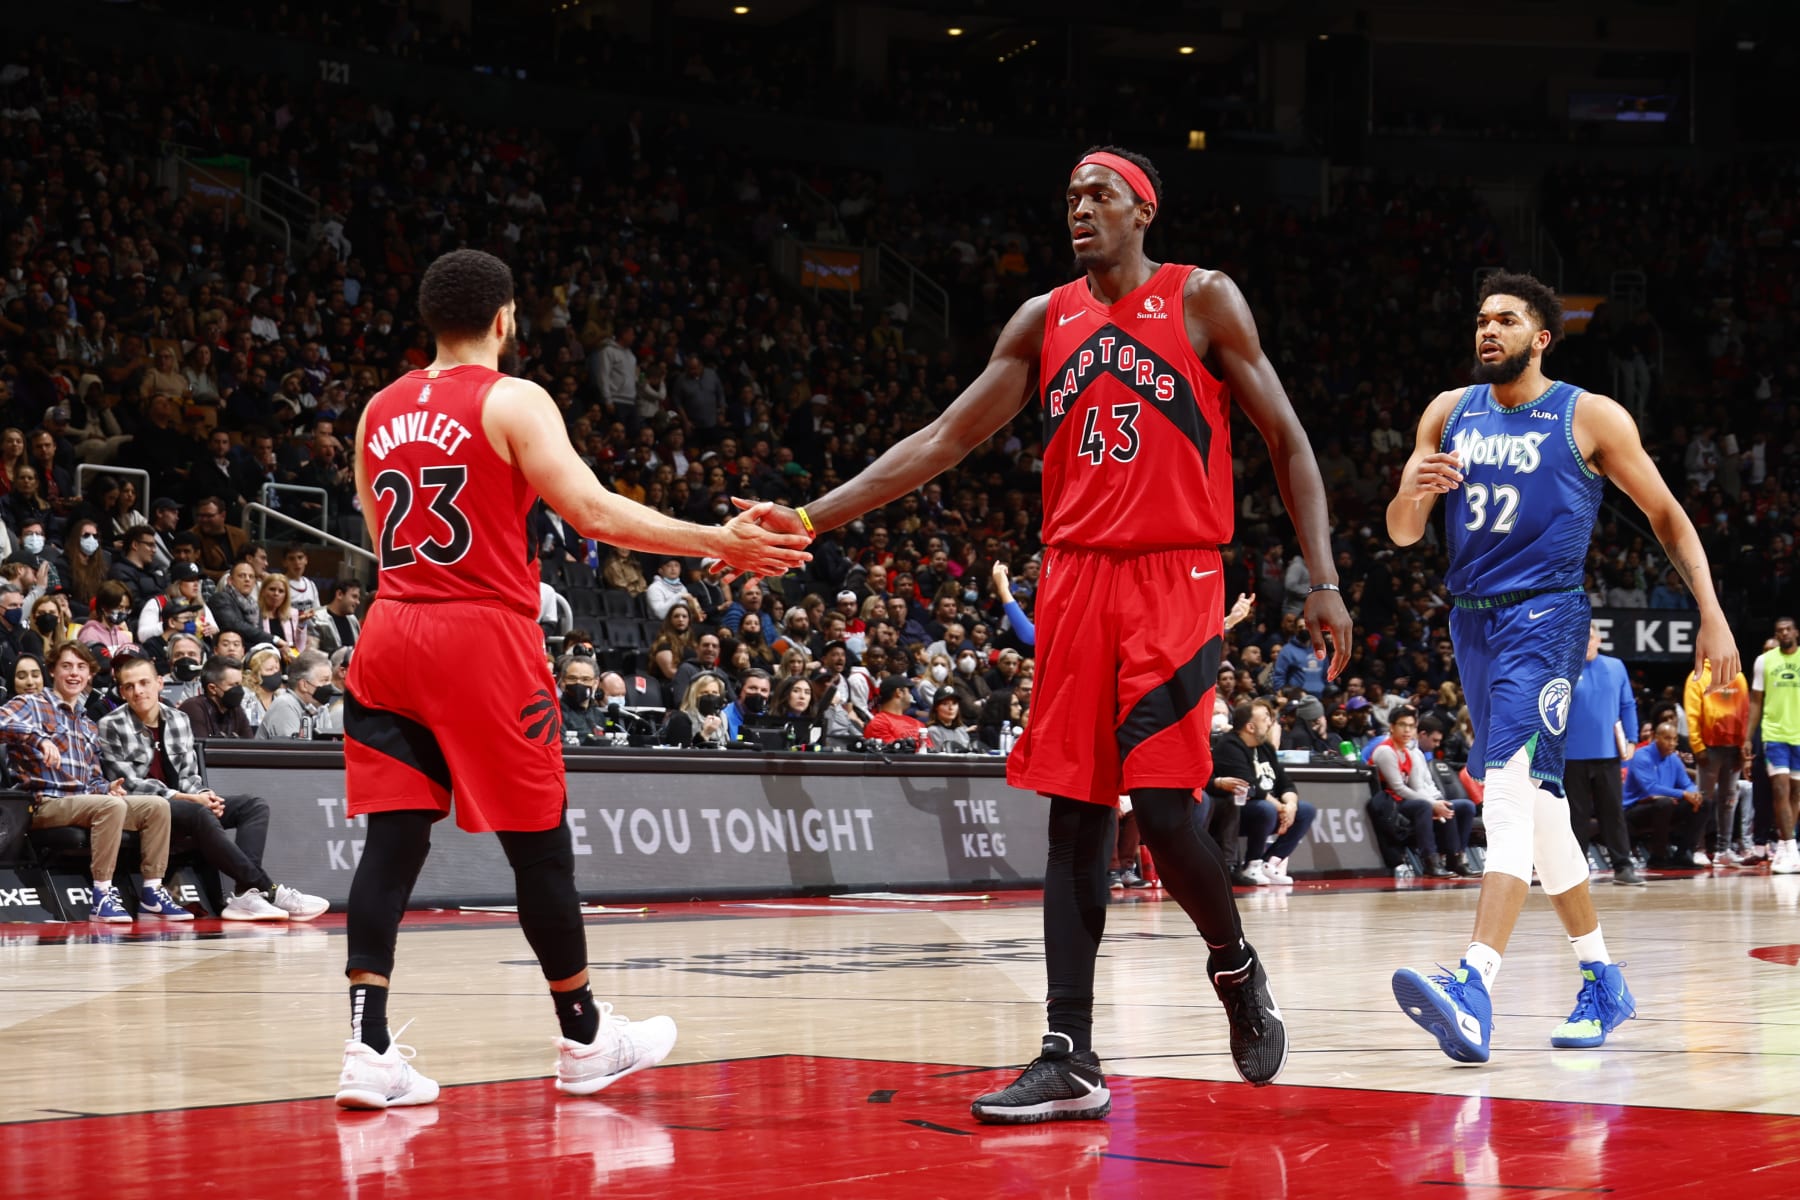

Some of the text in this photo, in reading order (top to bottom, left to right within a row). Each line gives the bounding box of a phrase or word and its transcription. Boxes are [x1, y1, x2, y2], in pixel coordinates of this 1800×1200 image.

[318, 60, 350, 84] 121
[1050, 337, 1175, 417] RAPTORS
[368, 411, 472, 460] VANVLEET
[1077, 402, 1141, 465] 43
[372, 464, 473, 571] 23
[1463, 481, 1520, 533] 32
[1635, 620, 1693, 653] KE
[599, 808, 691, 854] YOU
[701, 808, 873, 853] TONIGHT
[953, 799, 1000, 824] THE
[1311, 808, 1364, 843] KEG
[961, 833, 1006, 858] KEG
